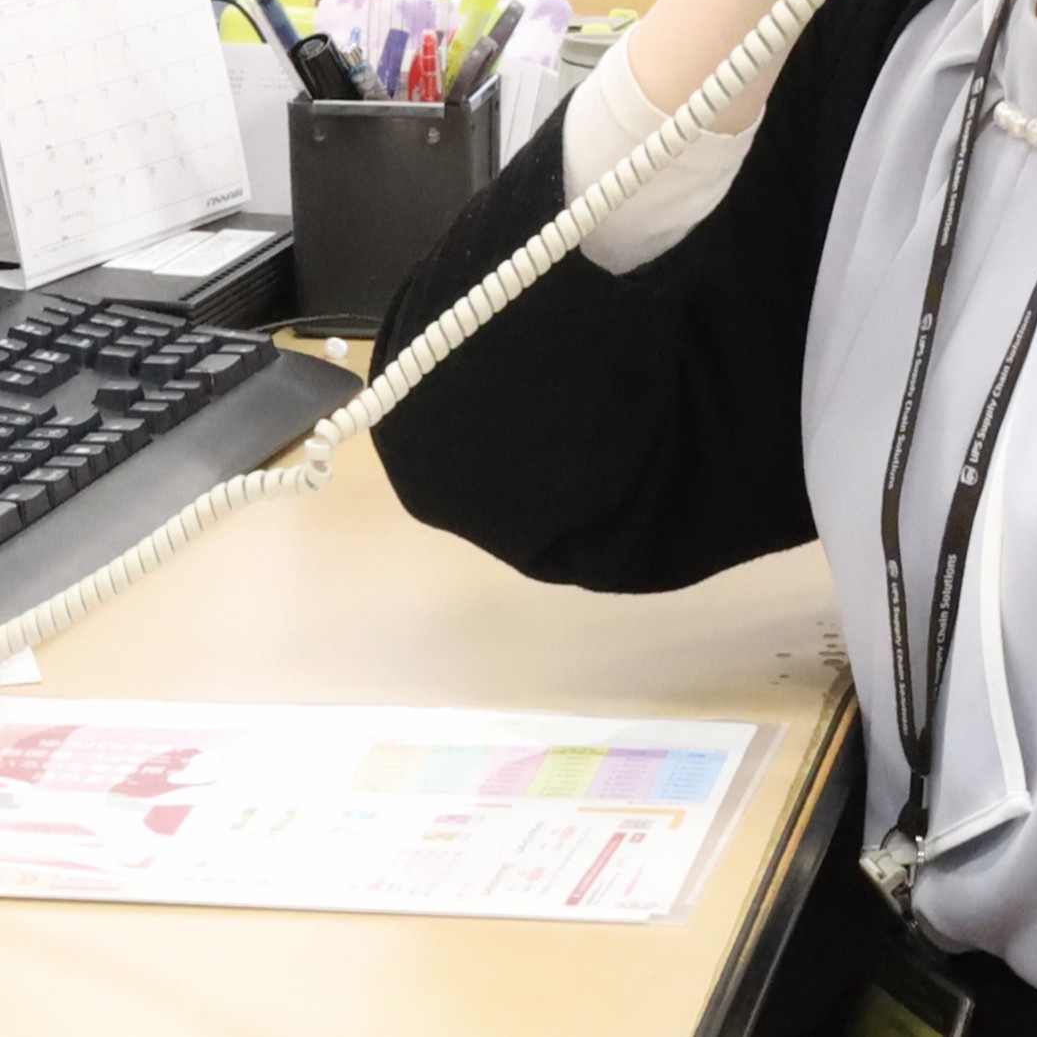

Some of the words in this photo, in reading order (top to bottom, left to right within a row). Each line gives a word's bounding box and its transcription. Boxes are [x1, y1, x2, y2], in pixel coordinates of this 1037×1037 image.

[1005, 310, 1032, 365] Solutions
[992, 365, 1010, 398] Chain
[899, 400, 913, 432] Chain
[976, 397, 998, 441] Supply
[888, 434, 906, 490] Solutions
[969, 440, 984, 464] UPS
[940, 553, 957, 610] Solutions
[937, 611, 949, 643] Chain
